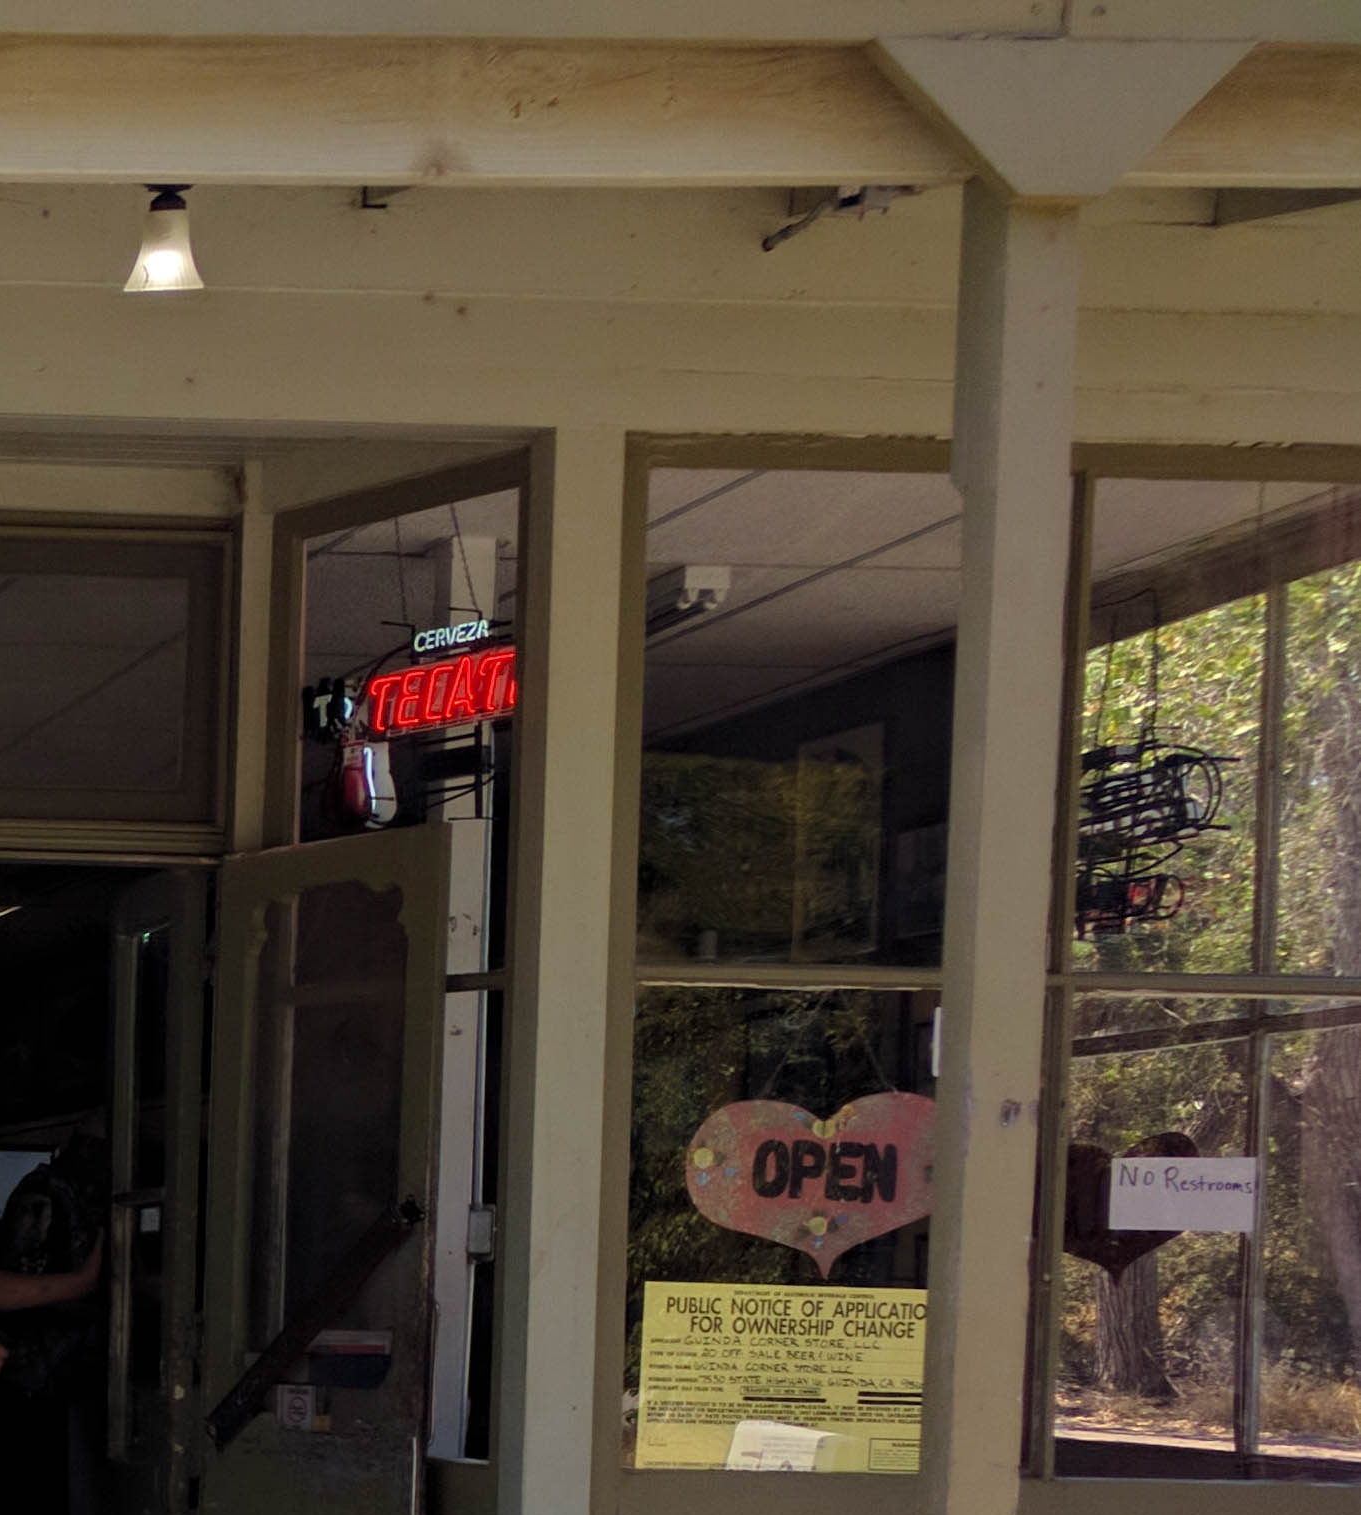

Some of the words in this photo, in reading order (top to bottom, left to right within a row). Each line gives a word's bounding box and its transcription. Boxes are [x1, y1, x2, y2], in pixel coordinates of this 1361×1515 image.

[413, 618, 490, 652] CERVEZA
[369, 648, 518, 733] TECAT
[751, 1138, 898, 1203] OPEN
[1163, 1166, 1253, 1194] Restrooms
[666, 1296, 722, 1315] PUBLIC
[730, 1297, 792, 1317] NOTICE
[801, 1300, 824, 1318] OF
[832, 1300, 928, 1321] APPLICATIO
[690, 1315, 723, 1334] FOR
[732, 1317, 835, 1336] OWNERSHIP
[843, 1319, 916, 1339] CHANGE
